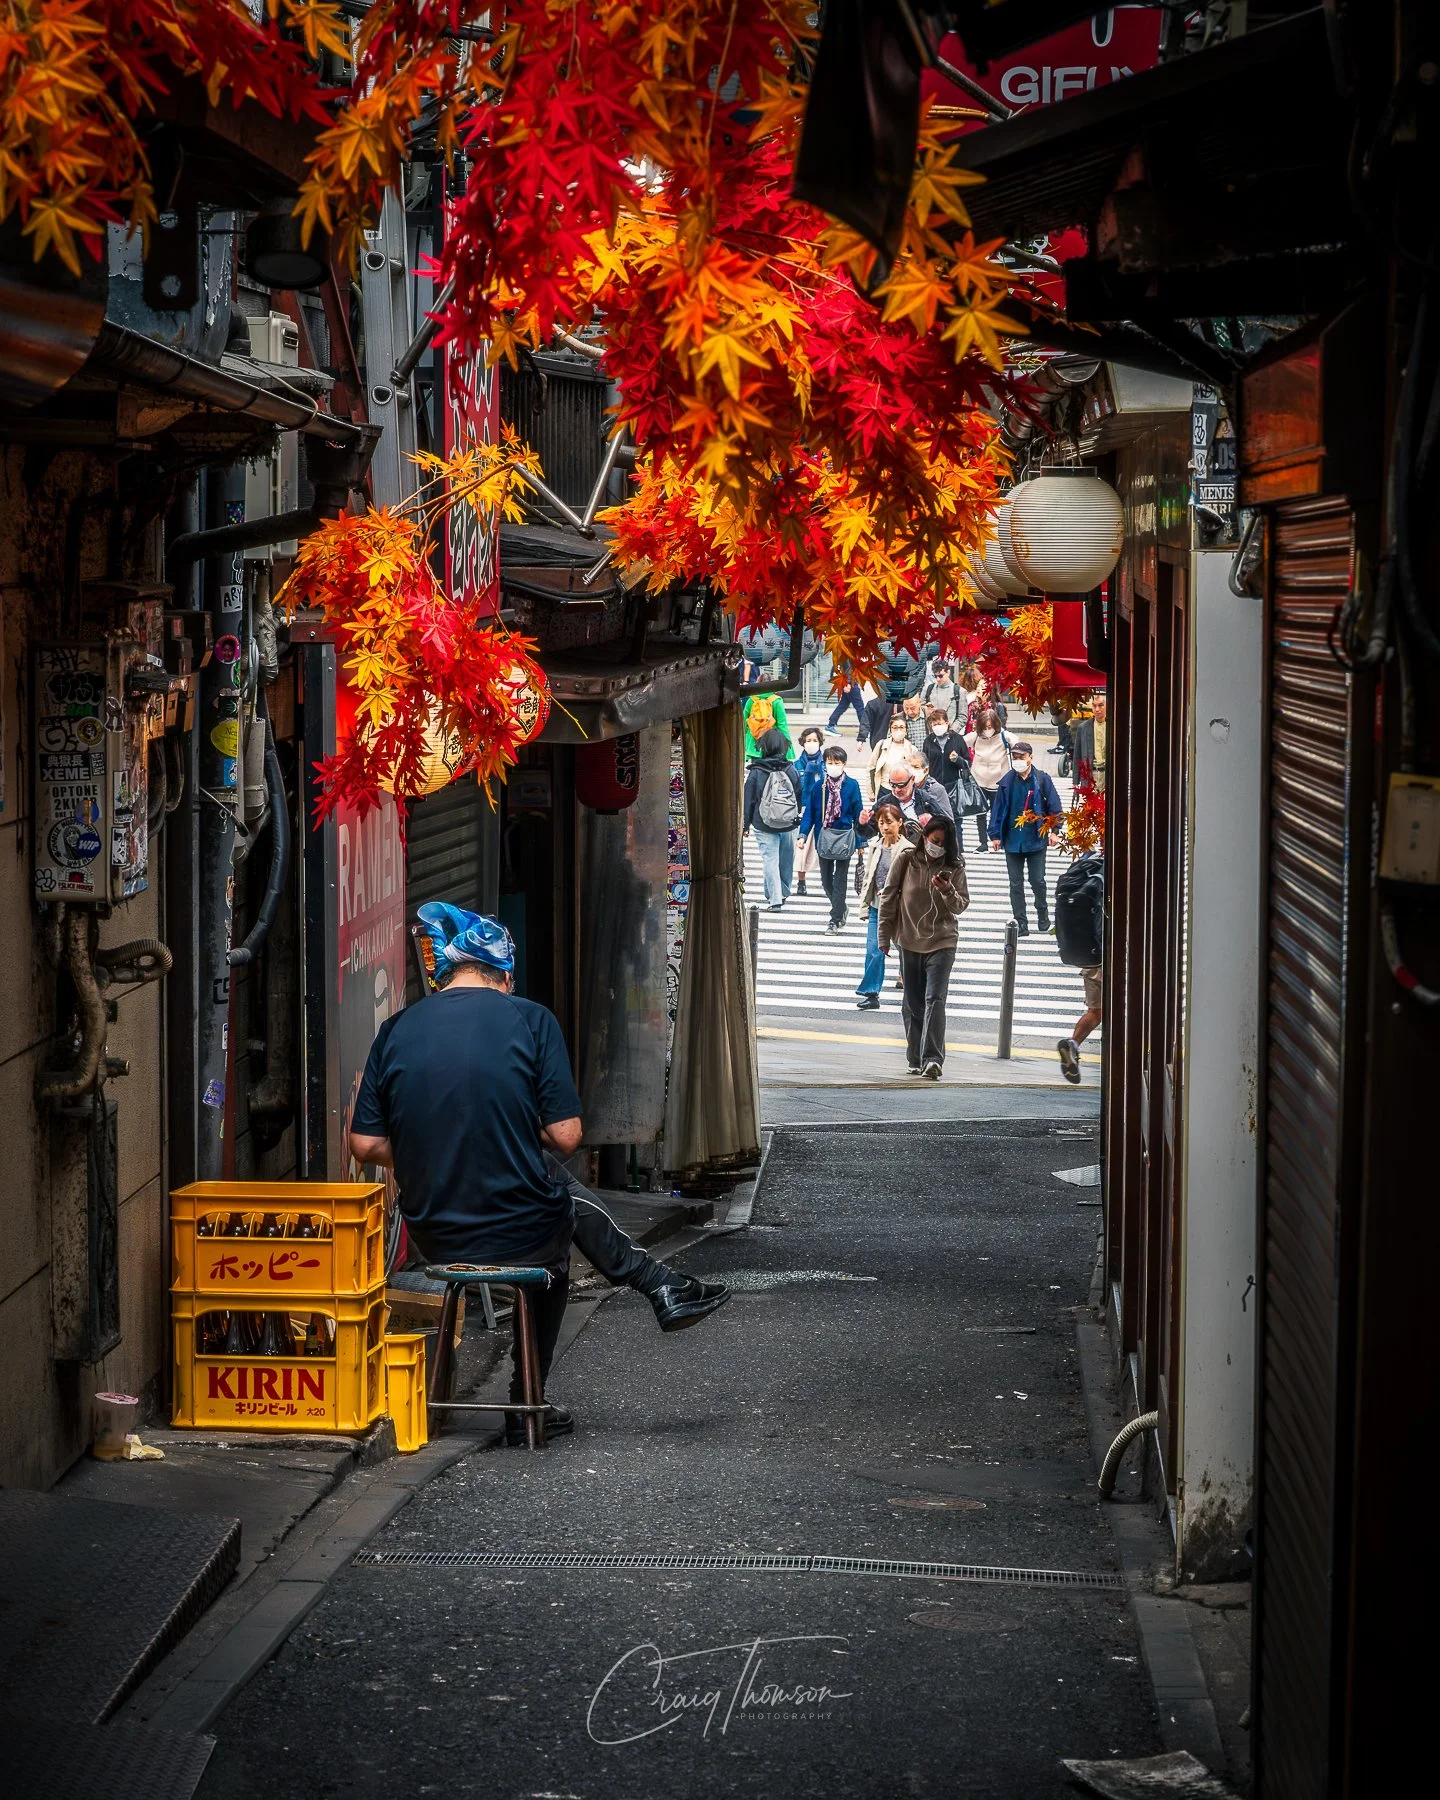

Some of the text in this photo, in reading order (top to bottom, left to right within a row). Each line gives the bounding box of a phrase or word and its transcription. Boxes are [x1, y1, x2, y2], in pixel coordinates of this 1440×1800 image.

[1199, 486, 1235, 500] MENIS
[42, 767, 90, 781] XEME
[78, 839, 100, 851] WIP
[338, 802, 403, 926] RAMEN
[350, 914, 394, 974] ICHIKAKUYA
[209, 1251, 321, 1281] ホッピー
[207, 1366, 325, 1402] KIRIN
[235, 1402, 298, 1417] キリンビール
